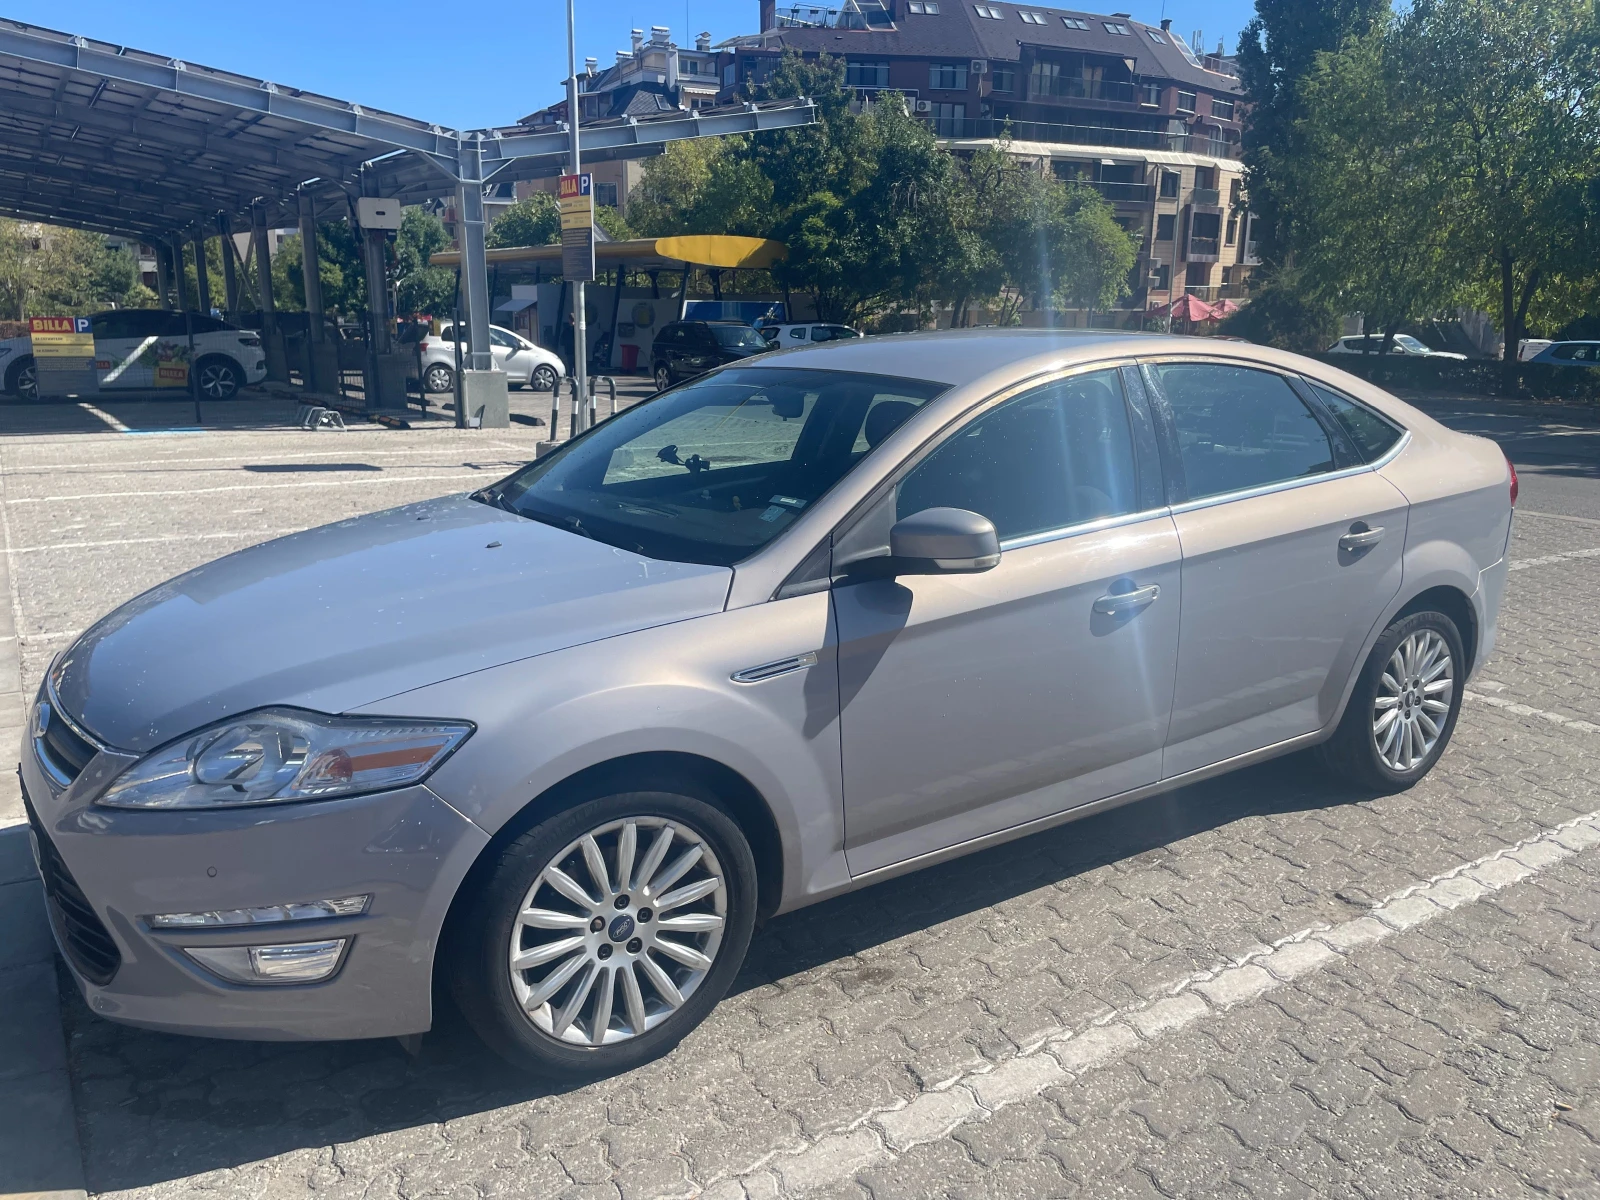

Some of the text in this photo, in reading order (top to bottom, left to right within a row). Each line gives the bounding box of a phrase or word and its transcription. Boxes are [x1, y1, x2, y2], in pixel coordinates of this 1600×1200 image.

[561, 176, 589, 195] BILLA P
[33, 319, 89, 332] BILLA P
